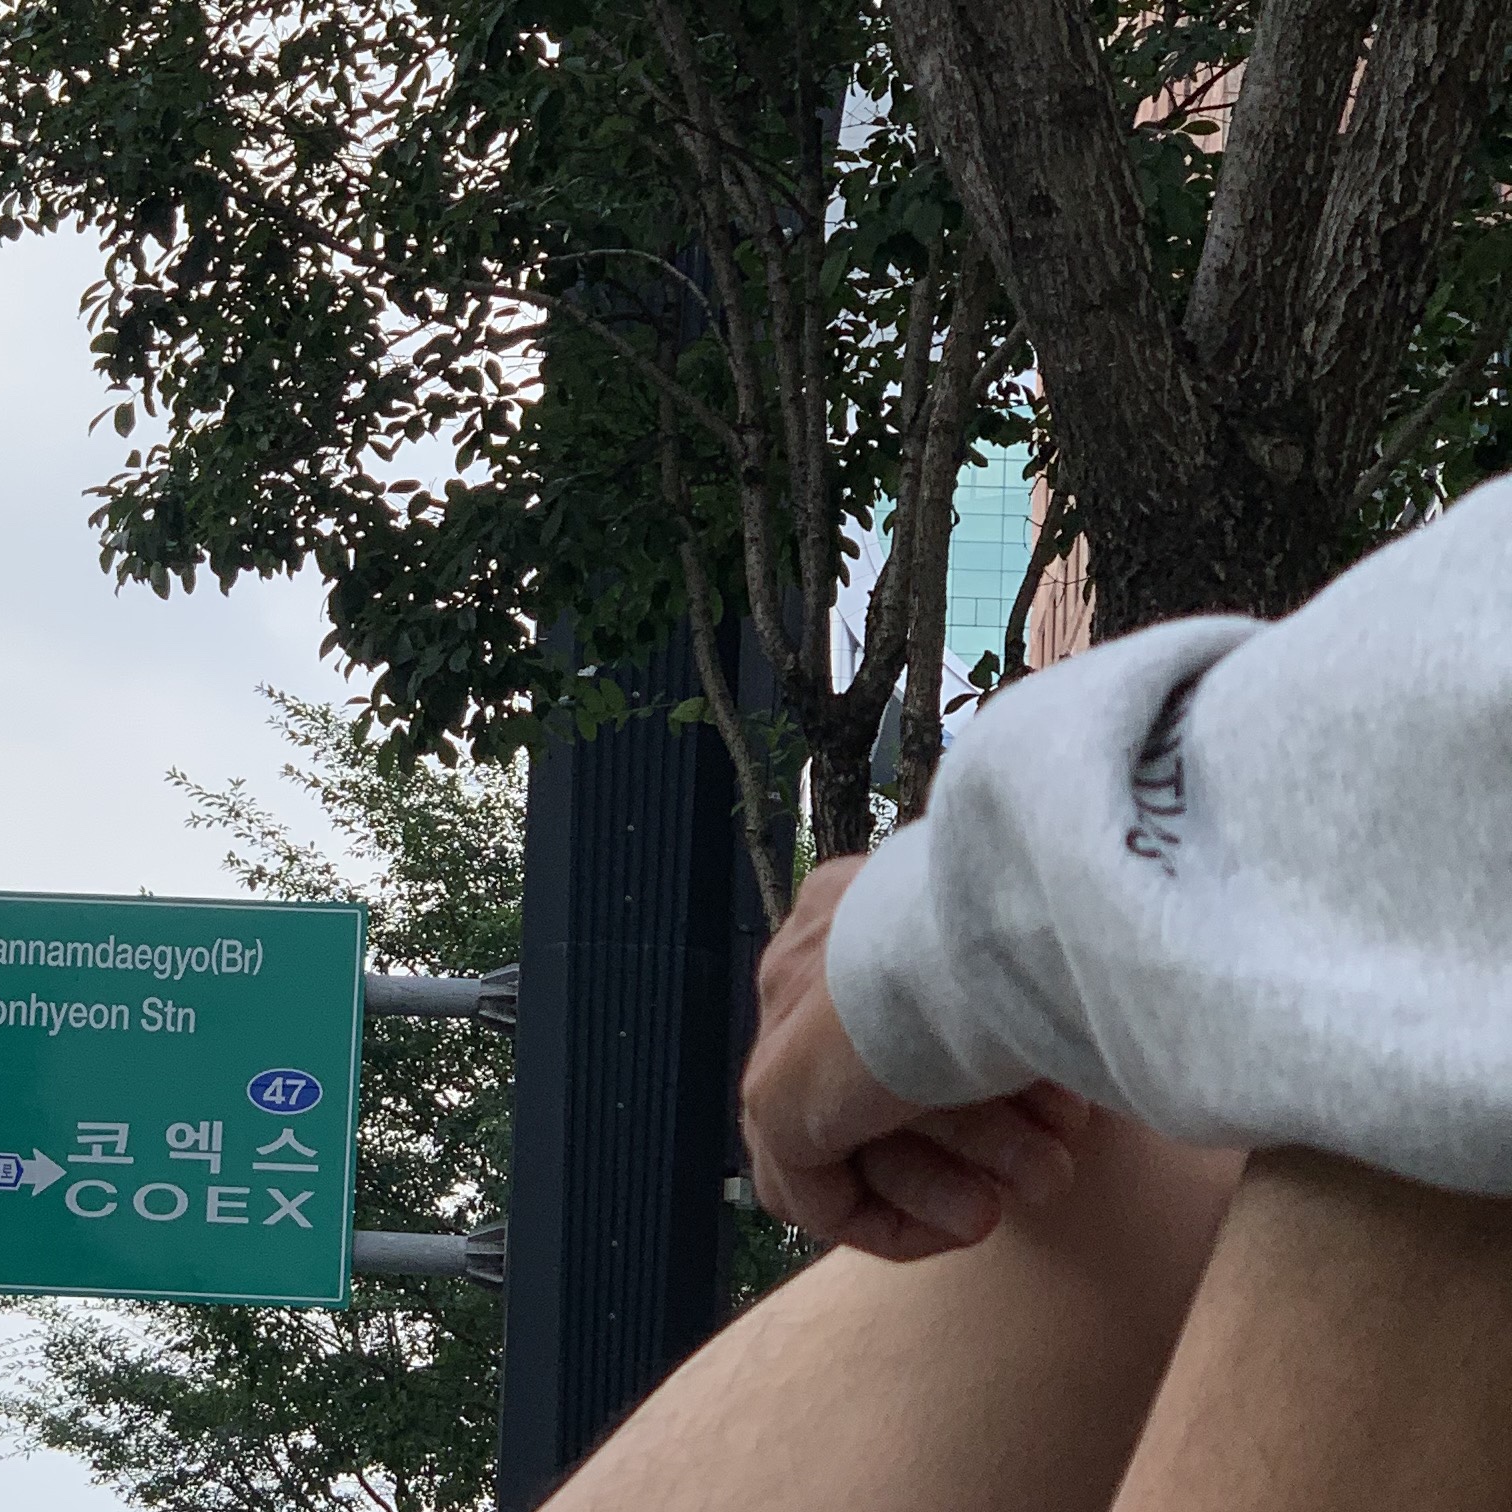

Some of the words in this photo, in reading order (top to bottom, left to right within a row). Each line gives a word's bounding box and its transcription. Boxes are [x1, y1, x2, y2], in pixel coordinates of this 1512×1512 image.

[140, 996, 196, 1034] Stn
[262, 1078, 307, 1106] 47
[64, 1179, 316, 1229] COEX
